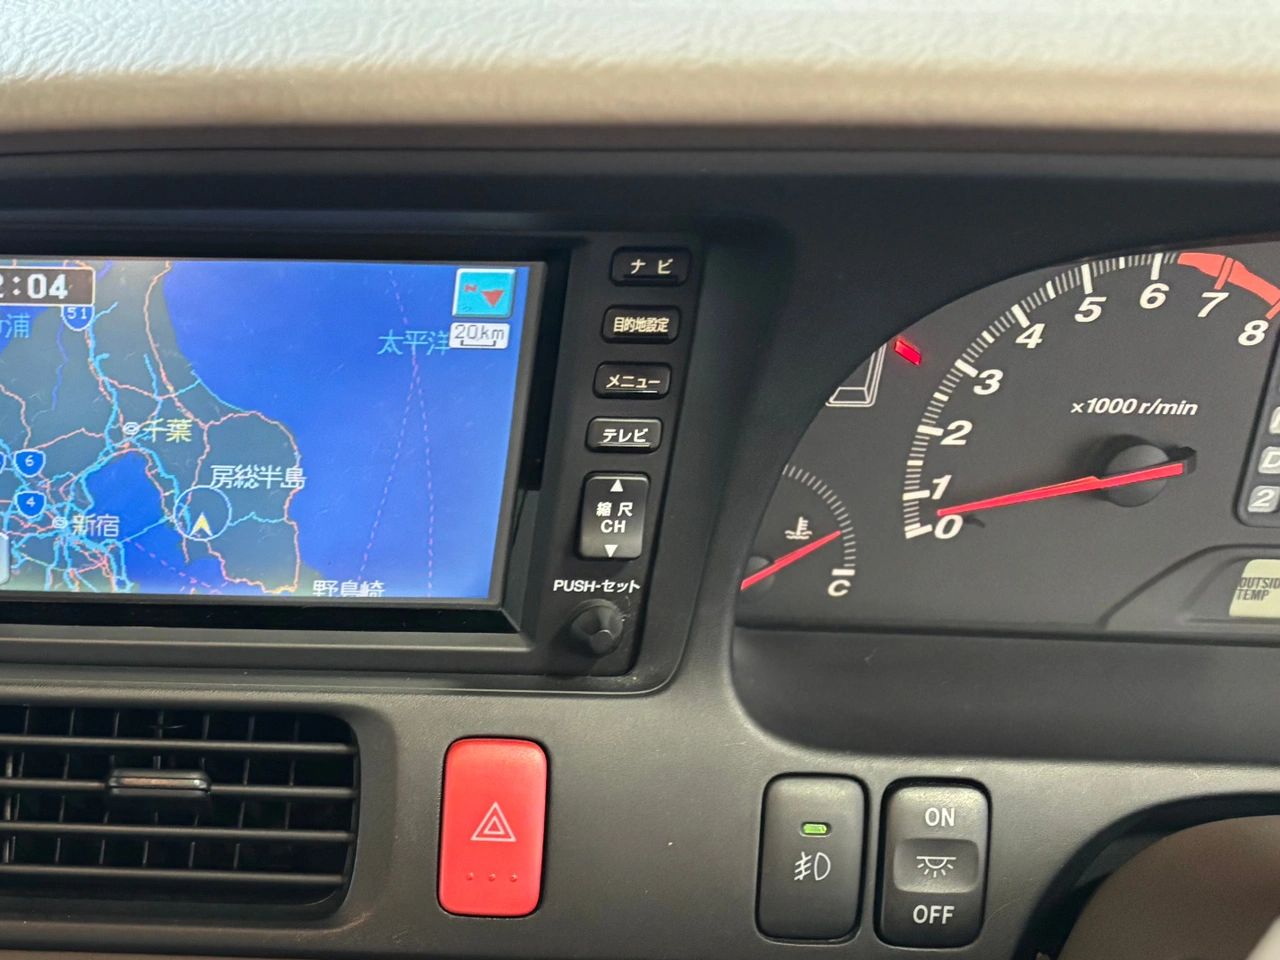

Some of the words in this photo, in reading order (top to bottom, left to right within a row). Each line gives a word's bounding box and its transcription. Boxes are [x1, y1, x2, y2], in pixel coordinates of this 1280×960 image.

[629, 258, 674, 275] ナビ
[1139, 282, 1170, 310] 6
[1197, 292, 1230, 318] 7
[67, 306, 87, 320] 51
[1074, 296, 1107, 324] 5
[613, 317, 669, 333] 目的地設定
[1238, 320, 1269, 346] 8
[1015, 323, 1046, 349] 4
[606, 375, 661, 389] メニュー
[973, 368, 1004, 396] 3
[1138, 397, 1198, 415] r/min
[143, 418, 193, 443] 千葉
[602, 428, 649, 443] テレビ
[941, 420, 973, 446] 2
[25, 455, 35, 467] 6
[210, 464, 308, 489] 房総半島
[930, 475, 952, 500] 1
[26, 496, 36, 507] 4
[1251, 490, 1275, 507] 2
[71, 513, 120, 538] 新宿
[601, 519, 626, 534] CH
[933, 514, 964, 539] 0
[553, 580, 641, 593] PUSH-セット
[828, 579, 851, 597] C
[1240, 577, 1280, 589] OUTSID
[1238, 589, 1269, 601] TEMP
[925, 808, 955, 827] ON
[912, 905, 955, 925] OFF
